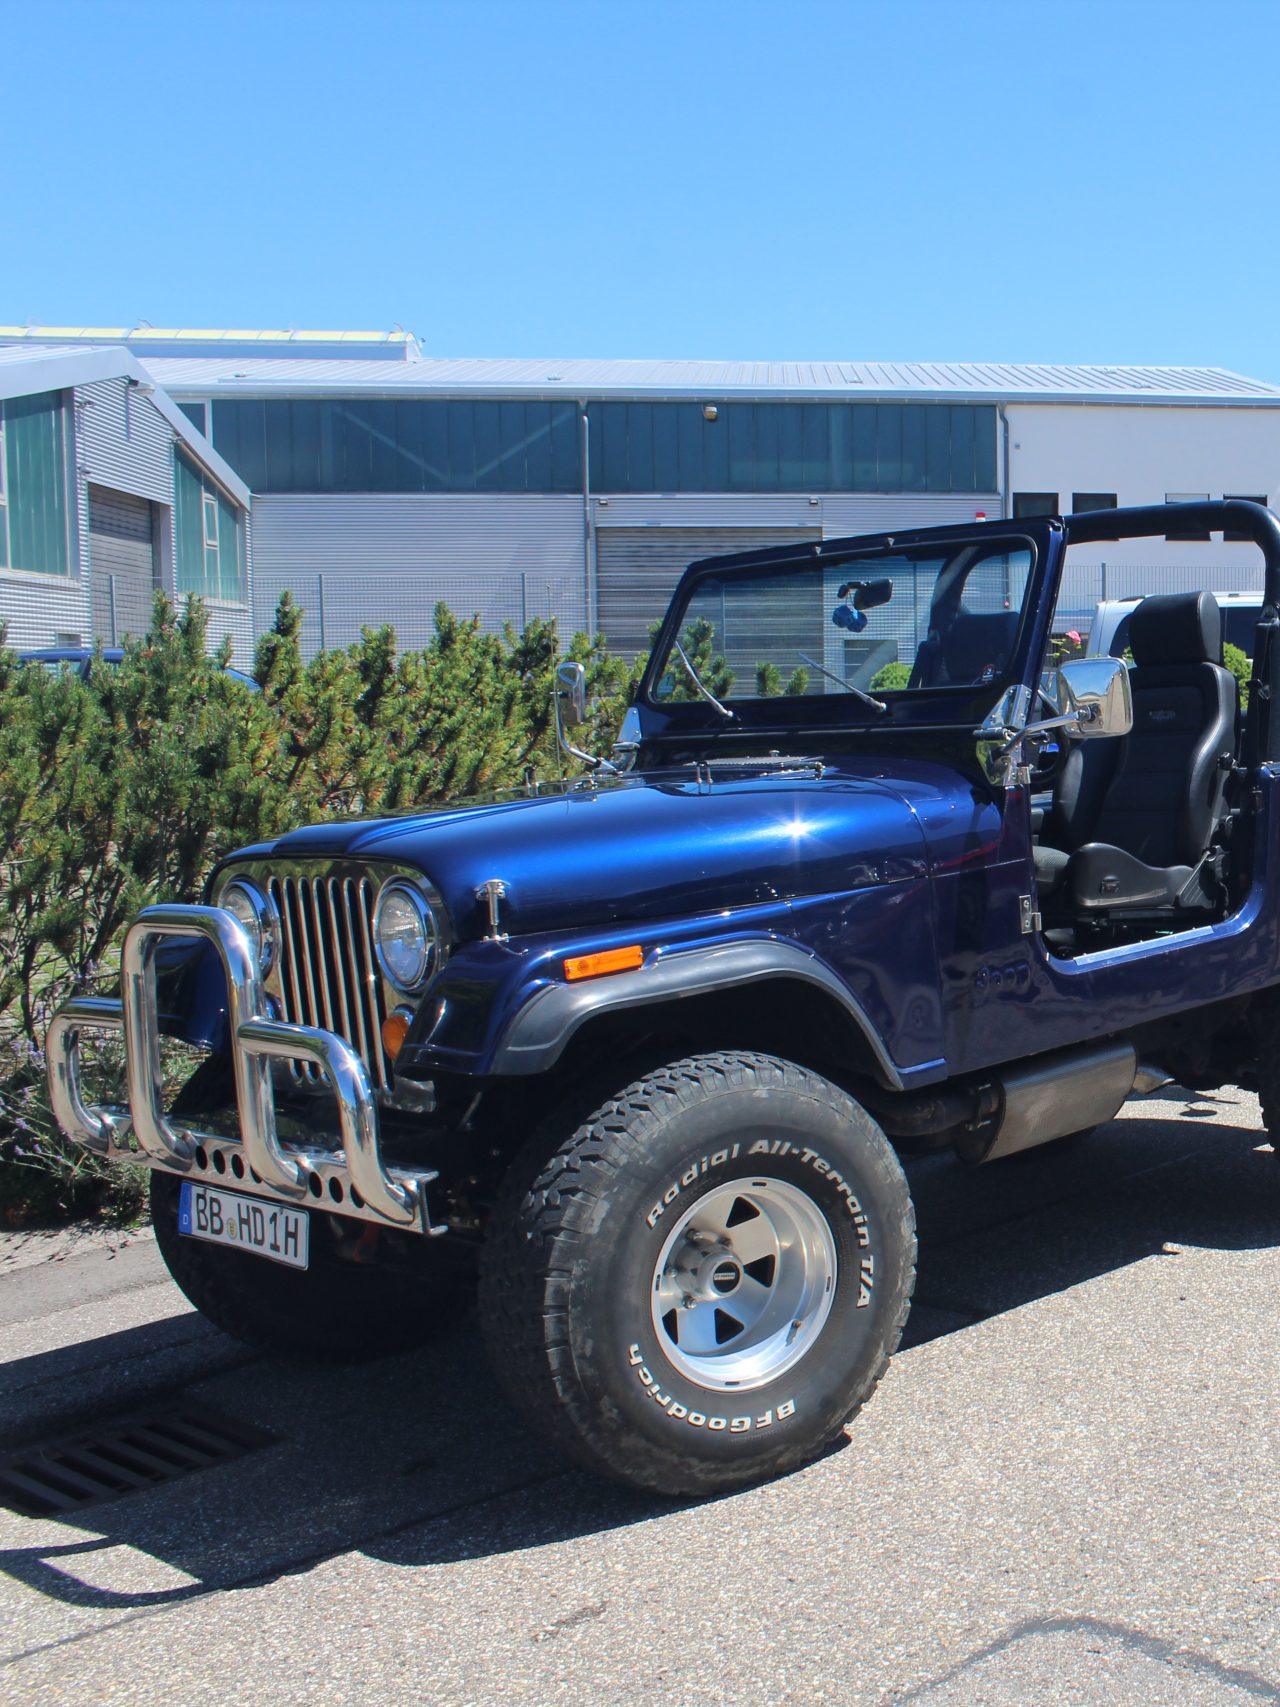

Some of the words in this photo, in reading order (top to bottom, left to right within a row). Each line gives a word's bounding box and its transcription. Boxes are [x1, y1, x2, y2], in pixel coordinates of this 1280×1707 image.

[182, 1214, 189, 1225] D
[196, 1192, 224, 1236] BB
[645, 1143, 740, 1229] Radial
[748, 1139, 870, 1249] All-Terrain
[856, 1254, 875, 1309] T/A
[628, 1343, 796, 1433] BFGoodrich
